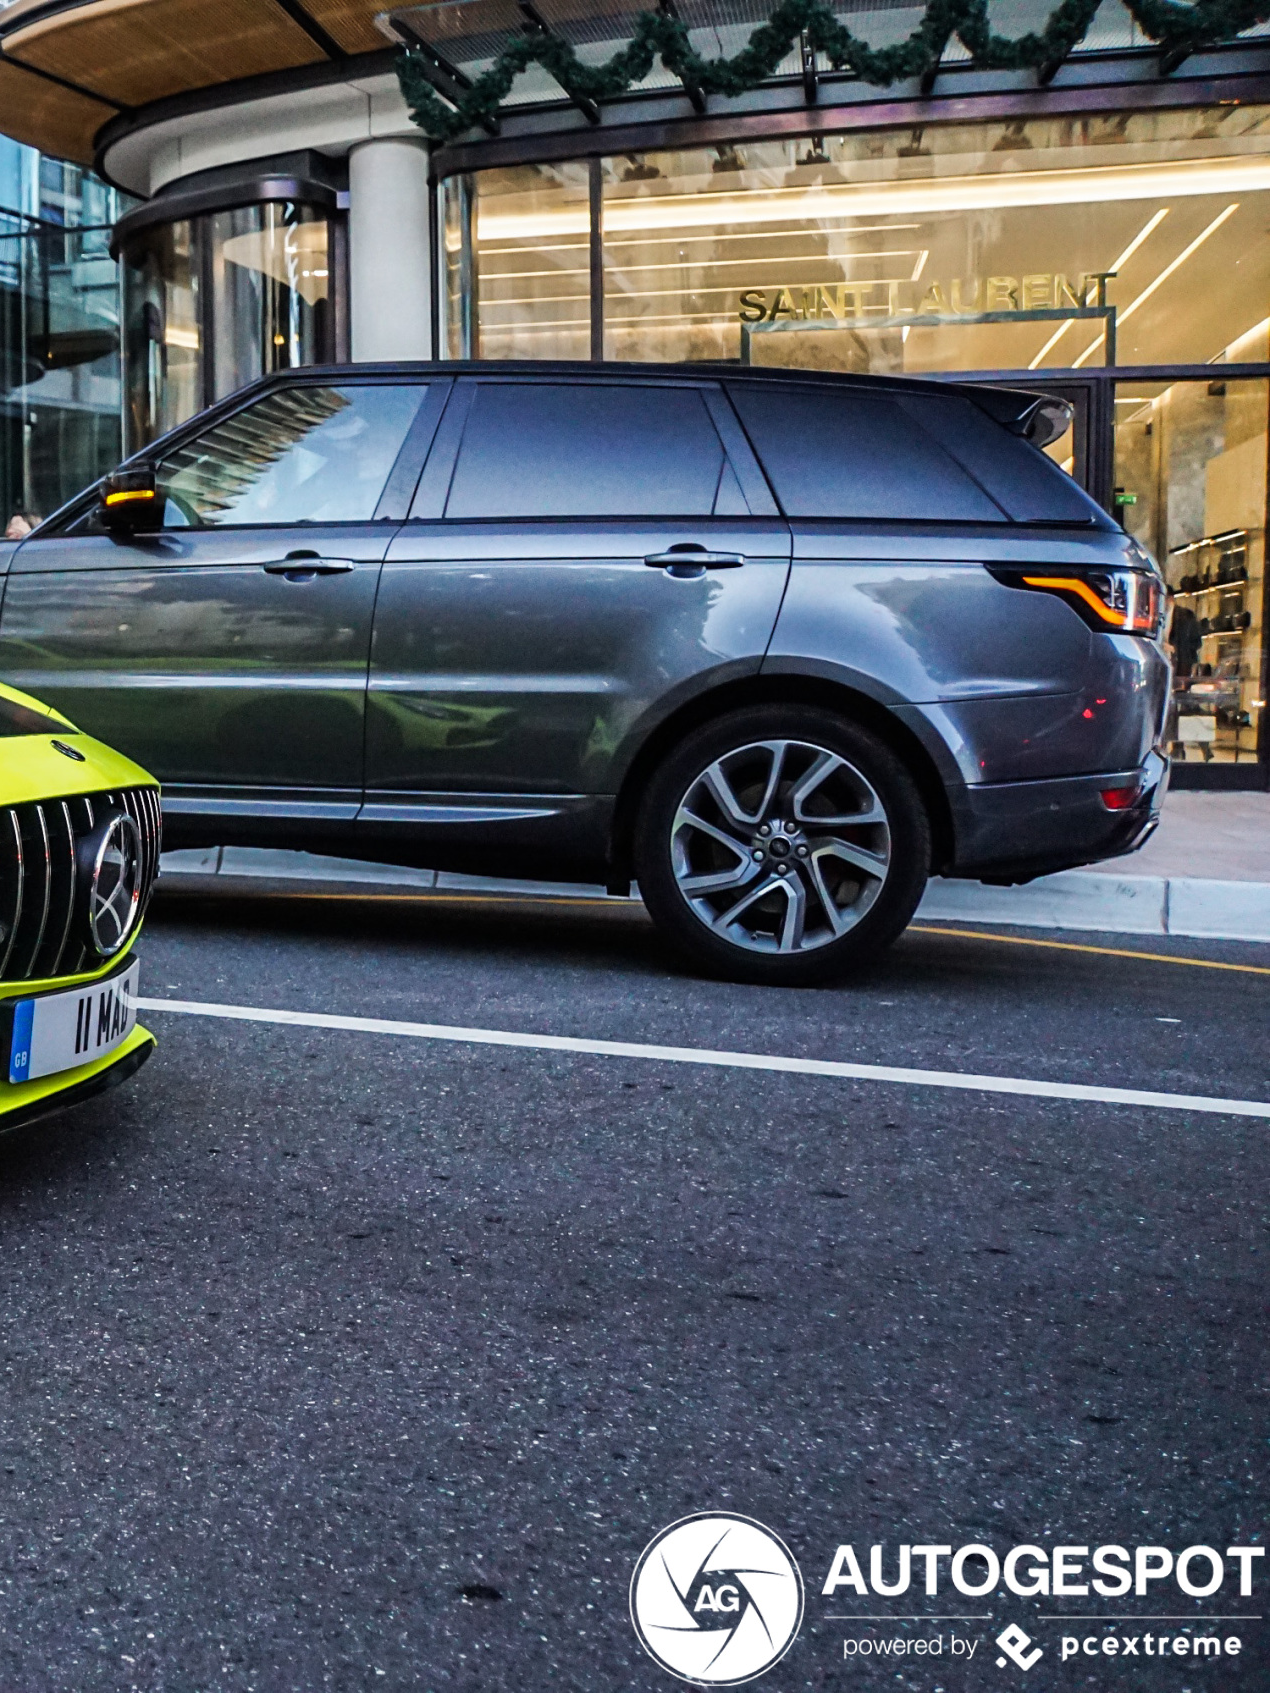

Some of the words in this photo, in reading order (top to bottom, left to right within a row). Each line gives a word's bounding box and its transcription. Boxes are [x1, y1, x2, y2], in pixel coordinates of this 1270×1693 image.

[738, 287, 873, 322] SAINT
[888, 271, 1118, 317] LAURENT
[14, 1051, 28, 1068] GB
